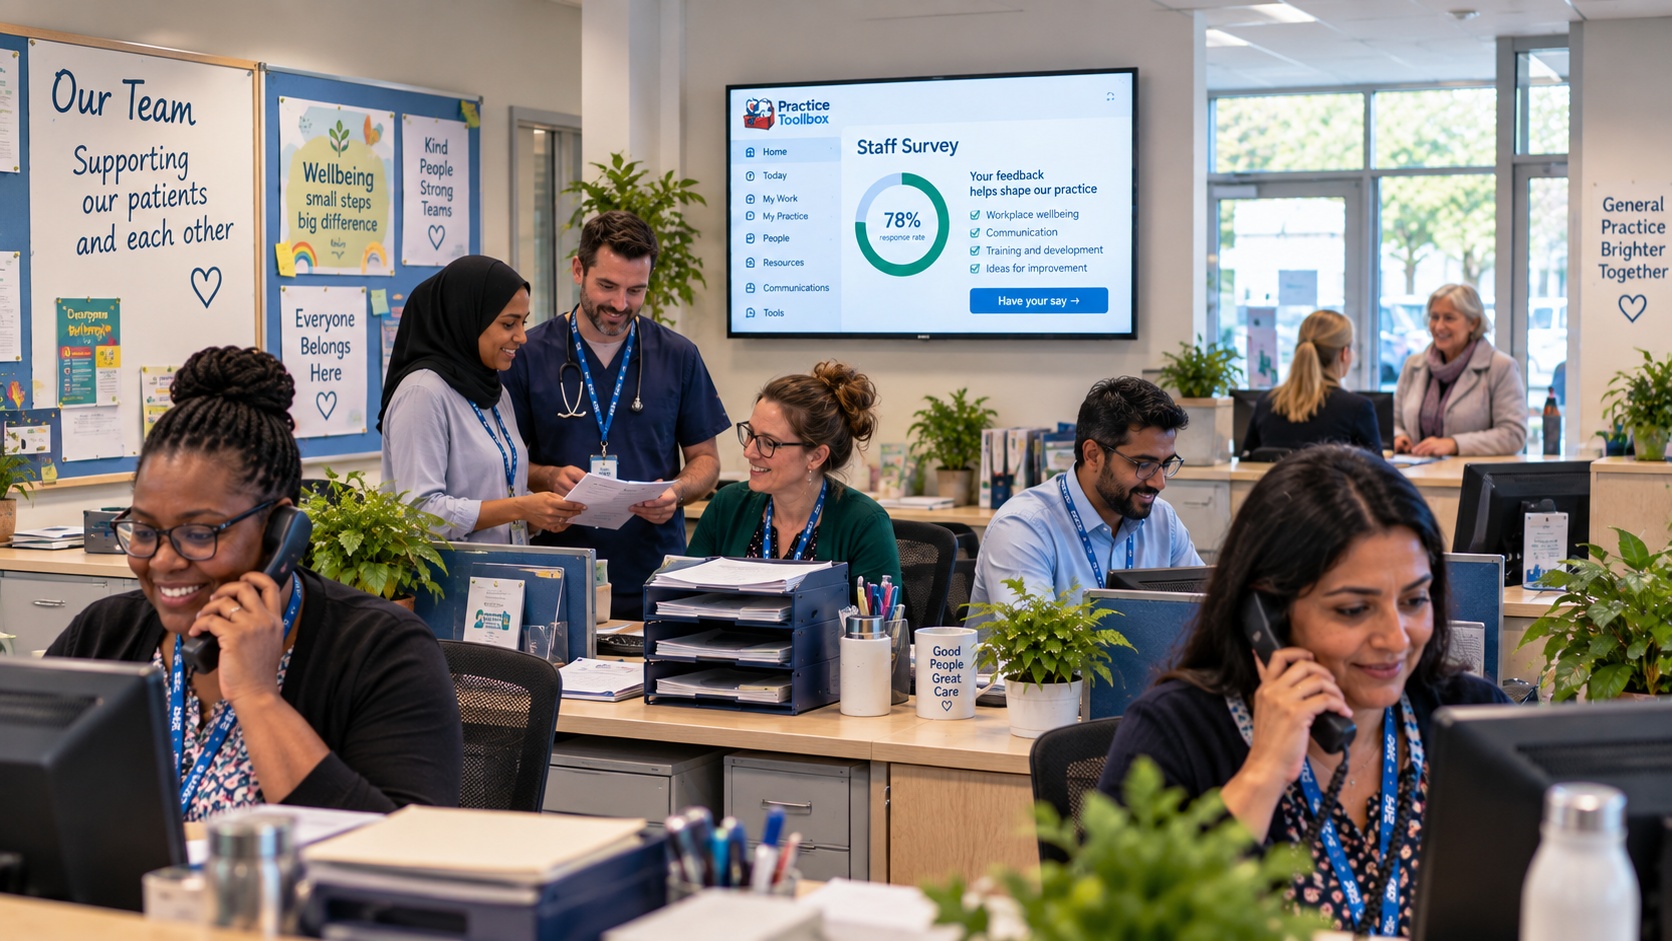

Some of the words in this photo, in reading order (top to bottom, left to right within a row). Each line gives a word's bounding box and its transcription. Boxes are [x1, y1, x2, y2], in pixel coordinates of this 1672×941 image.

[52, 68, 112, 116] Our
[122, 79, 196, 126] Team
[778, 99, 830, 112] Practice
[425, 137, 448, 155] Kind
[763, 148, 787, 156] Home
[857, 138, 898, 155] Staff
[901, 138, 959, 157] Survey
[73, 145, 189, 185] Supporting
[420, 158, 453, 180] People
[303, 161, 374, 193] Wellbeing
[763, 171, 787, 181] Today
[970, 171, 994, 182] Your
[996, 169, 1045, 181] feedback
[420, 180, 453, 202] Strong
[970, 186, 998, 199] helps
[1000, 185, 1032, 198] shape
[1033, 186, 1052, 195] our
[1054, 183, 1098, 197] practice
[82, 193, 118, 215] our
[128, 182, 208, 223] patients
[340, 192, 372, 214] steps
[763, 195, 775, 205] My
[776, 194, 798, 203] Work
[1602, 195, 1665, 213] General
[421, 200, 452, 217] Teams
[986, 210, 1034, 221] Workplace
[1036, 209, 1080, 221] wellbeing
[298, 211, 317, 234] big
[321, 212, 378, 232] difference
[763, 212, 775, 223] My
[776, 211, 809, 221] Practice
[884, 211, 922, 229] 78%
[986, 227, 1058, 238] Communication
[1601, 218, 1666, 235] Practice
[76, 223, 117, 256] and
[127, 218, 175, 250] each
[183, 214, 234, 245] other
[763, 233, 790, 244] People
[986, 245, 1022, 257] Training
[1024, 245, 1042, 255] and
[1043, 245, 1104, 257] development
[1601, 240, 1666, 262] Brighter
[763, 258, 805, 267] Resources
[986, 263, 1010, 273] Ideas
[1012, 263, 1026, 273] for
[1028, 263, 1088, 275] improvement
[1598, 263, 1669, 284] Together
[763, 283, 830, 292] Communications
[998, 296, 1023, 306] Have
[1025, 297, 1048, 308] your
[1050, 297, 1067, 308] say
[295, 308, 355, 333] Everyone
[763, 308, 785, 317] Tools
[301, 335, 351, 360] Belongs
[310, 363, 342, 382] Here
[932, 645, 961, 657] Good
[930, 658, 964, 672] People
[932, 672, 962, 684] Great
[934, 686, 959, 697] Care
